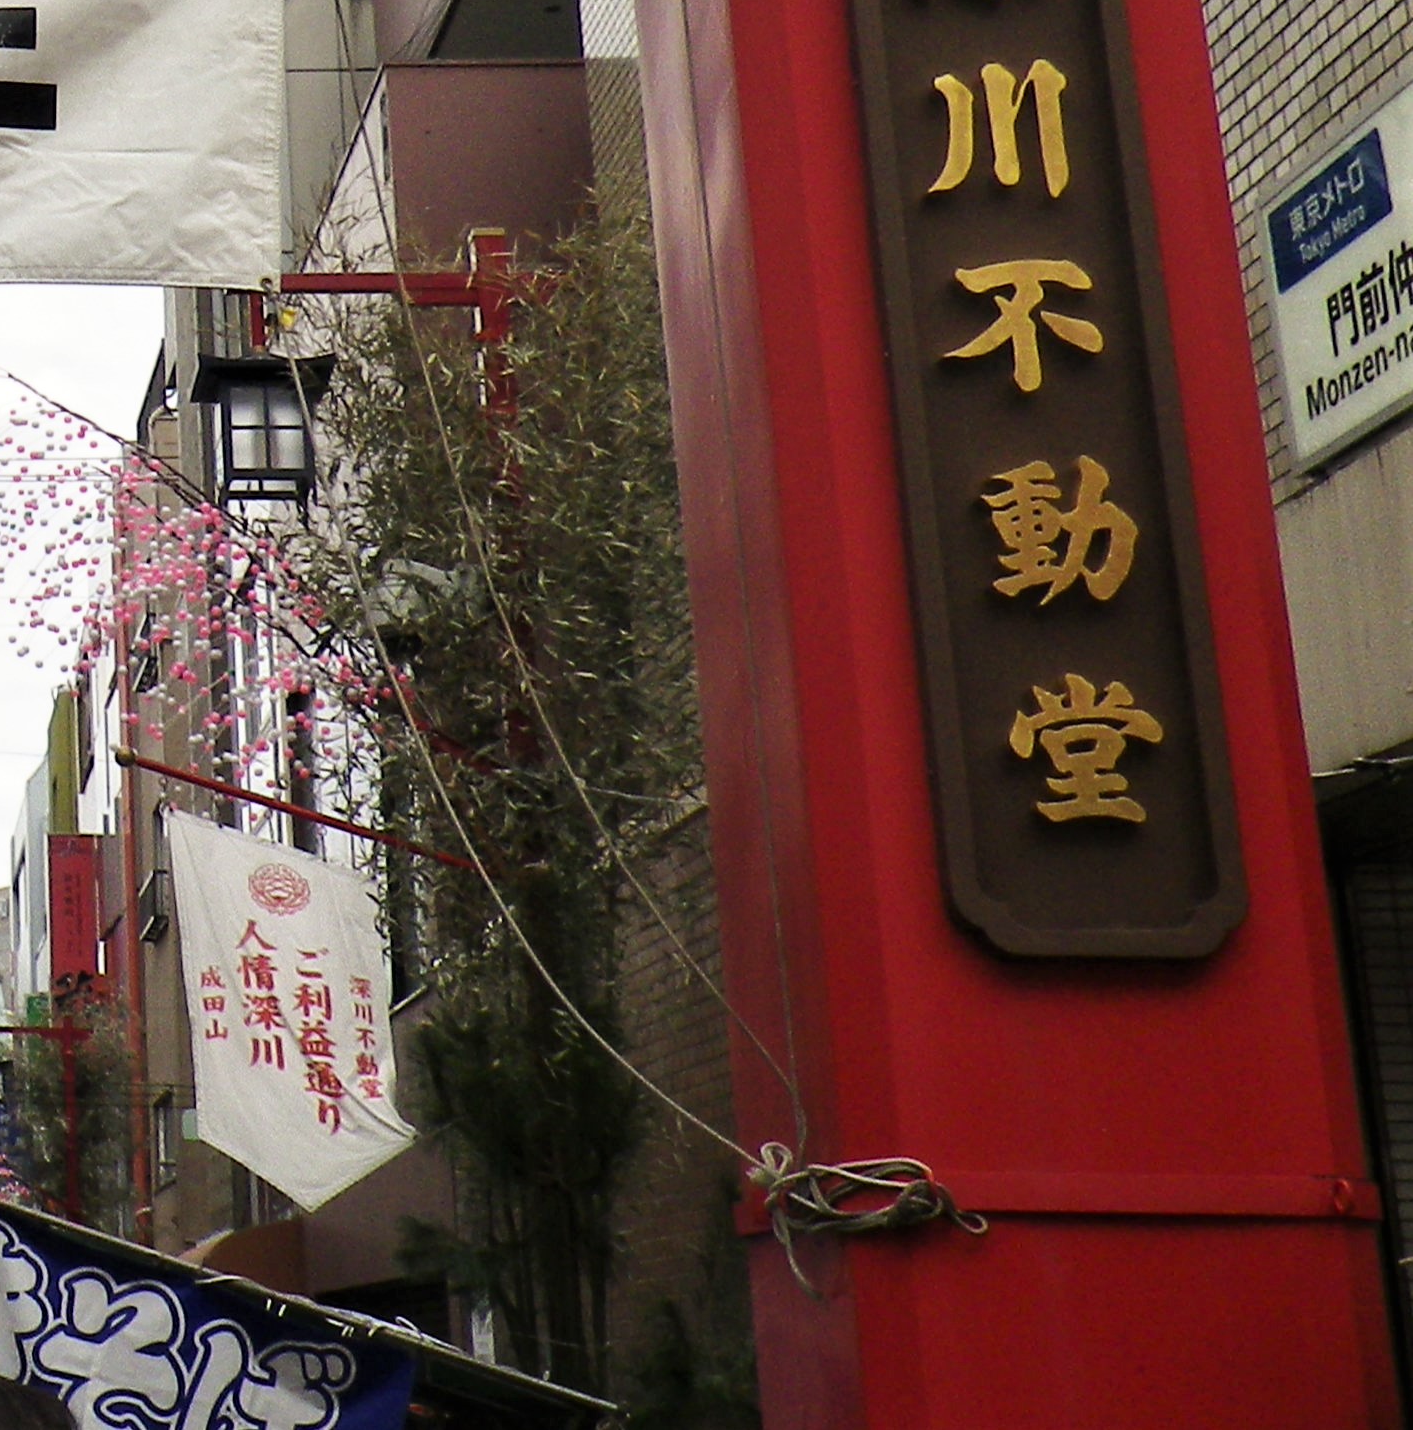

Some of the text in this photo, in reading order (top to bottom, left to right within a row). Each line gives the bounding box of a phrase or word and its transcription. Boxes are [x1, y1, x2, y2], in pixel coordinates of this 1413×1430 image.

[1288, 157, 1366, 242] 東京メトロ
[1298, 203, 1367, 265] Tokyo Metro
[200, 965, 229, 1041] 成田山
[236, 918, 286, 1072] 人情深川
[292, 947, 346, 1134] ご利益通り
[348, 974, 385, 1100] 深川不動堂
